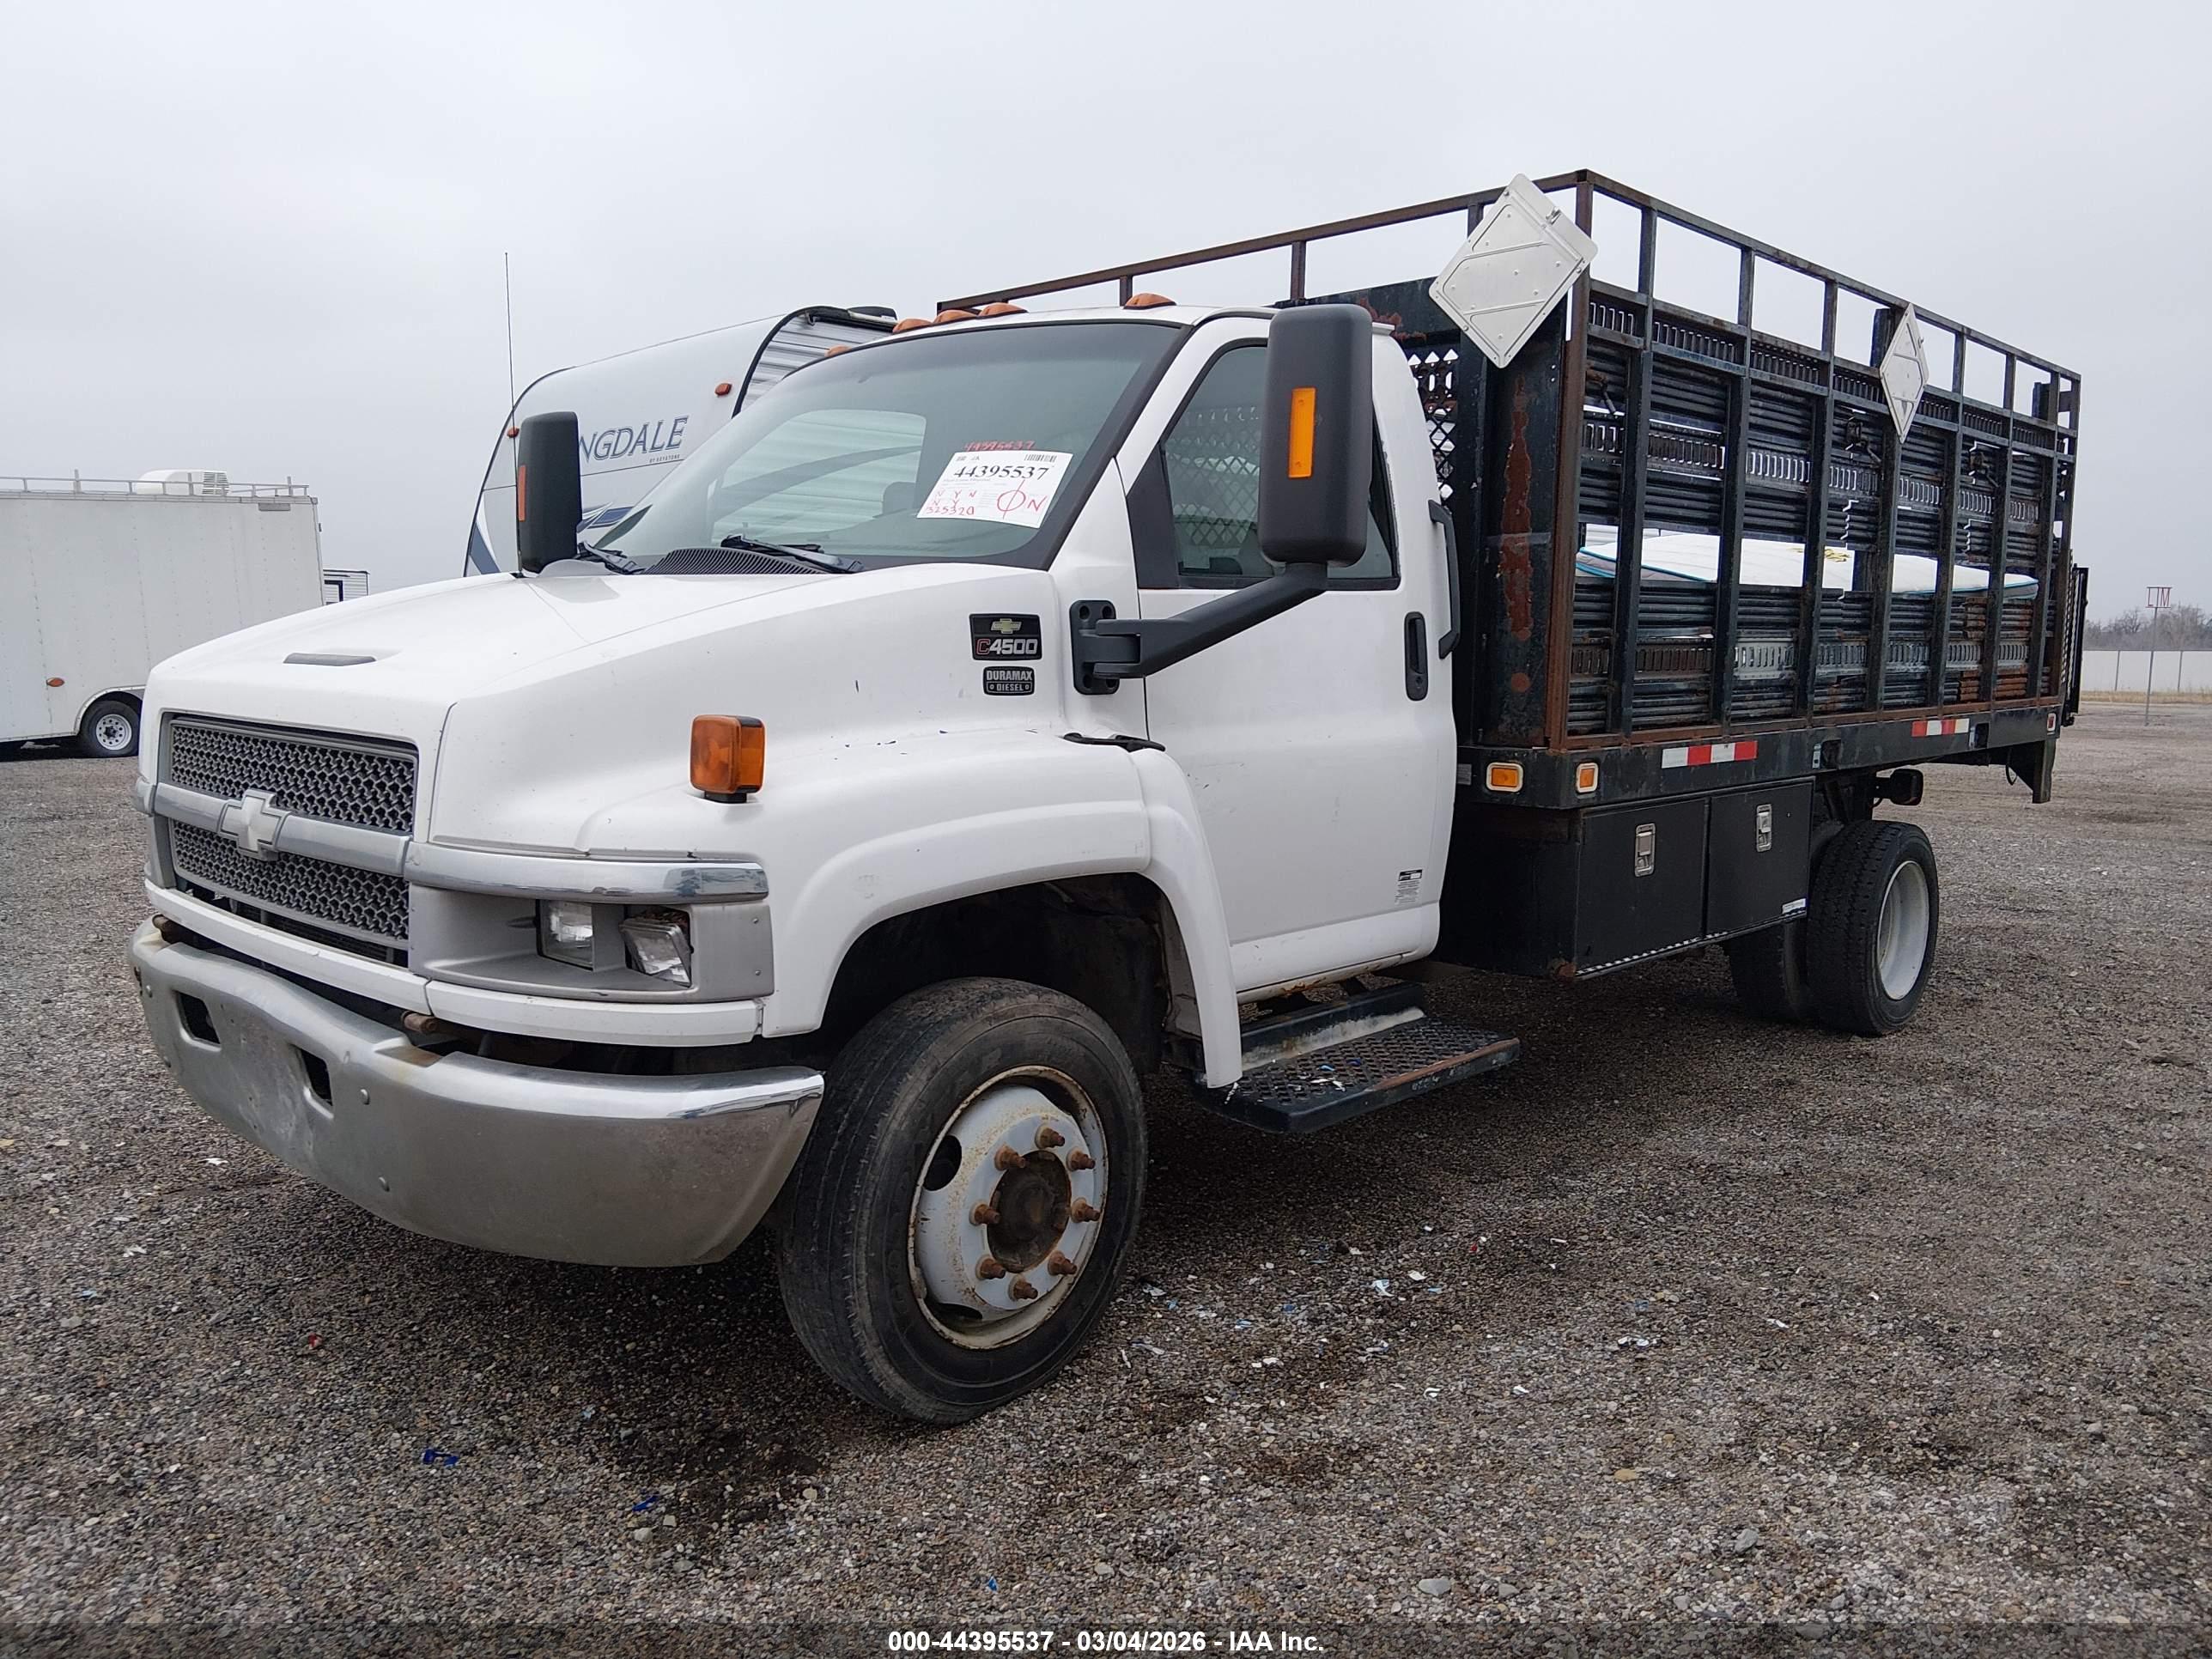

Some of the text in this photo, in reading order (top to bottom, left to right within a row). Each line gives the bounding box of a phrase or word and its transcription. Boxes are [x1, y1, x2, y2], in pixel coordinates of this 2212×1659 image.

[579, 416, 690, 463] NGDALE
[954, 465, 1049, 481] 44395537
[976, 638, 1038, 654] C4500
[987, 670, 1032, 681] DURAMAX
